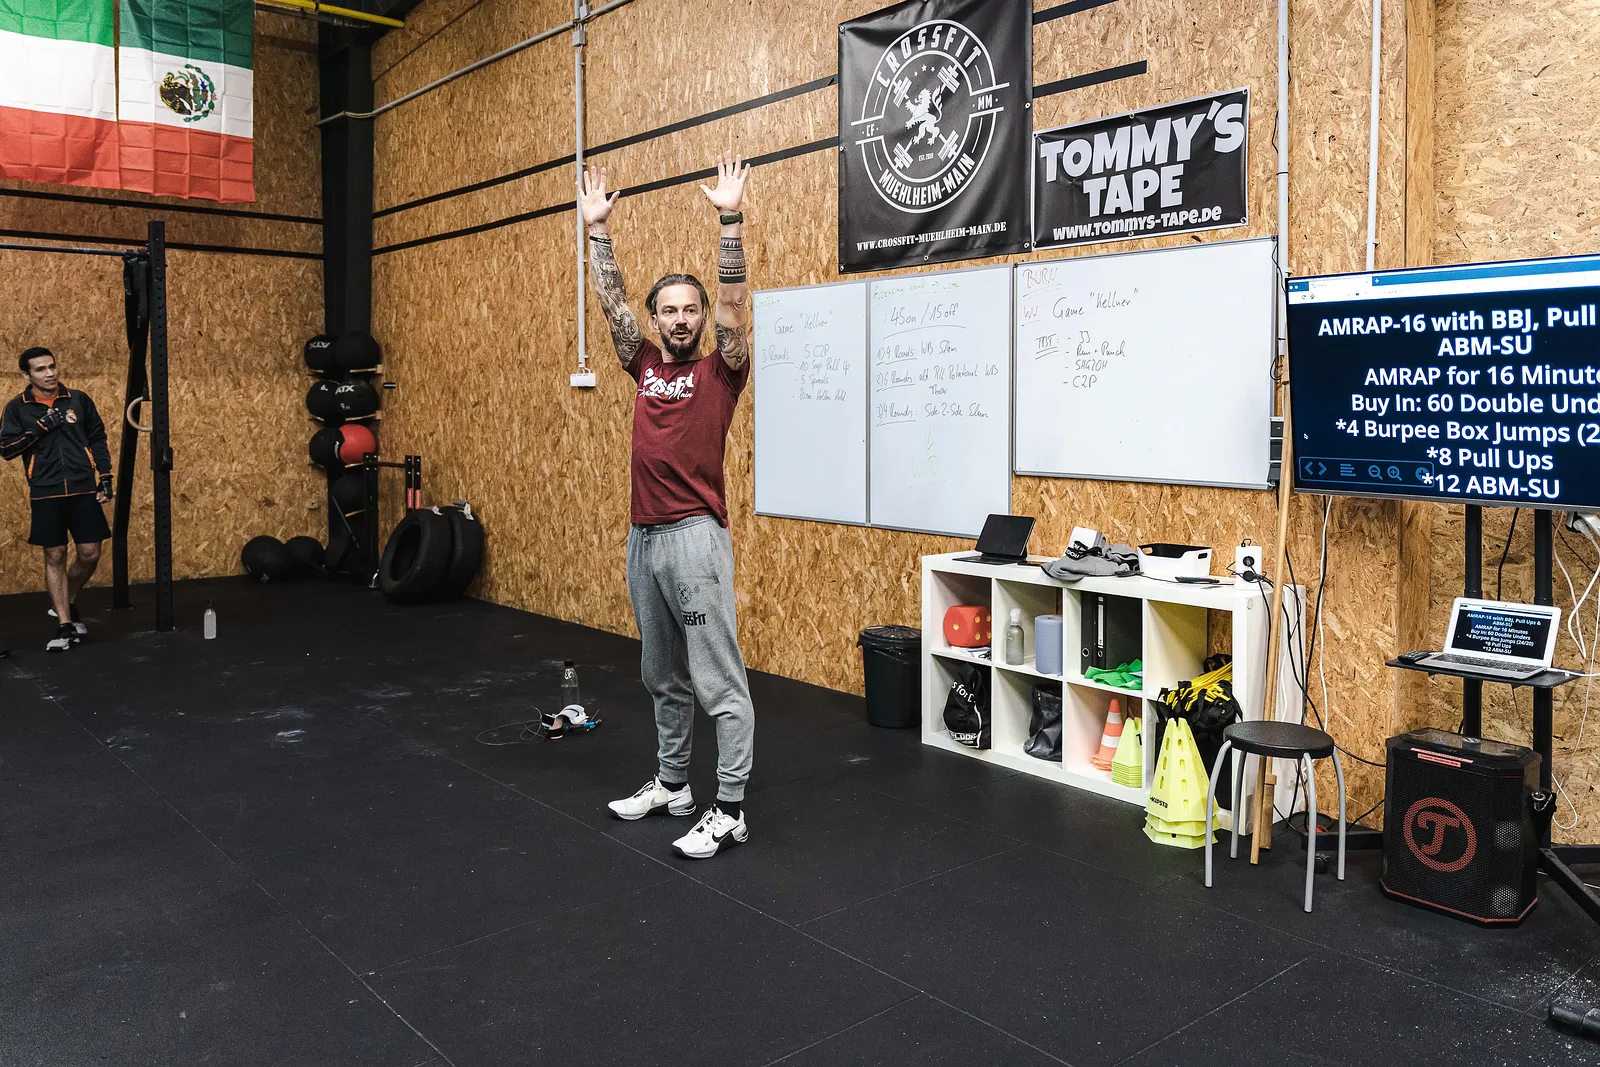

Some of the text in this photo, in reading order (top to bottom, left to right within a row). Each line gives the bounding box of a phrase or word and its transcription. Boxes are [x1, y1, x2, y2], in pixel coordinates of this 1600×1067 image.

[876, 25, 982, 88] CROSSFIT
[978, 94, 993, 111] MM
[866, 124, 875, 137] CF
[1039, 100, 1244, 183] TOMMY'S
[878, 152, 976, 206] MUEHLHEIM-MAIN
[1082, 164, 1184, 218] TAPE
[856, 221, 1007, 252] WWW.CROSSFIT-MUEHLHEIM-MAIN.DE
[1053, 296, 1084, 319] Game
[1318, 304, 1596, 337] AMRAP-16 with BBJ, Pull
[1438, 335, 1533, 357] ABM-SU
[1364, 365, 1600, 386] AMRAP for 16 Minut
[335, 384, 355, 395] ATX
[1351, 394, 1391, 416] Buy
[1396, 394, 1422, 413] In:
[1427, 394, 1454, 413] 60
[1461, 394, 1544, 414] Double
[1364, 420, 1440, 443] Burpee
[1446, 421, 1489, 441] Box
[1493, 421, 1570, 448] Jumps
[1459, 449, 1500, 469] Pull
[1507, 449, 1554, 472] Ups
[1466, 476, 1560, 499] ABM-SU
